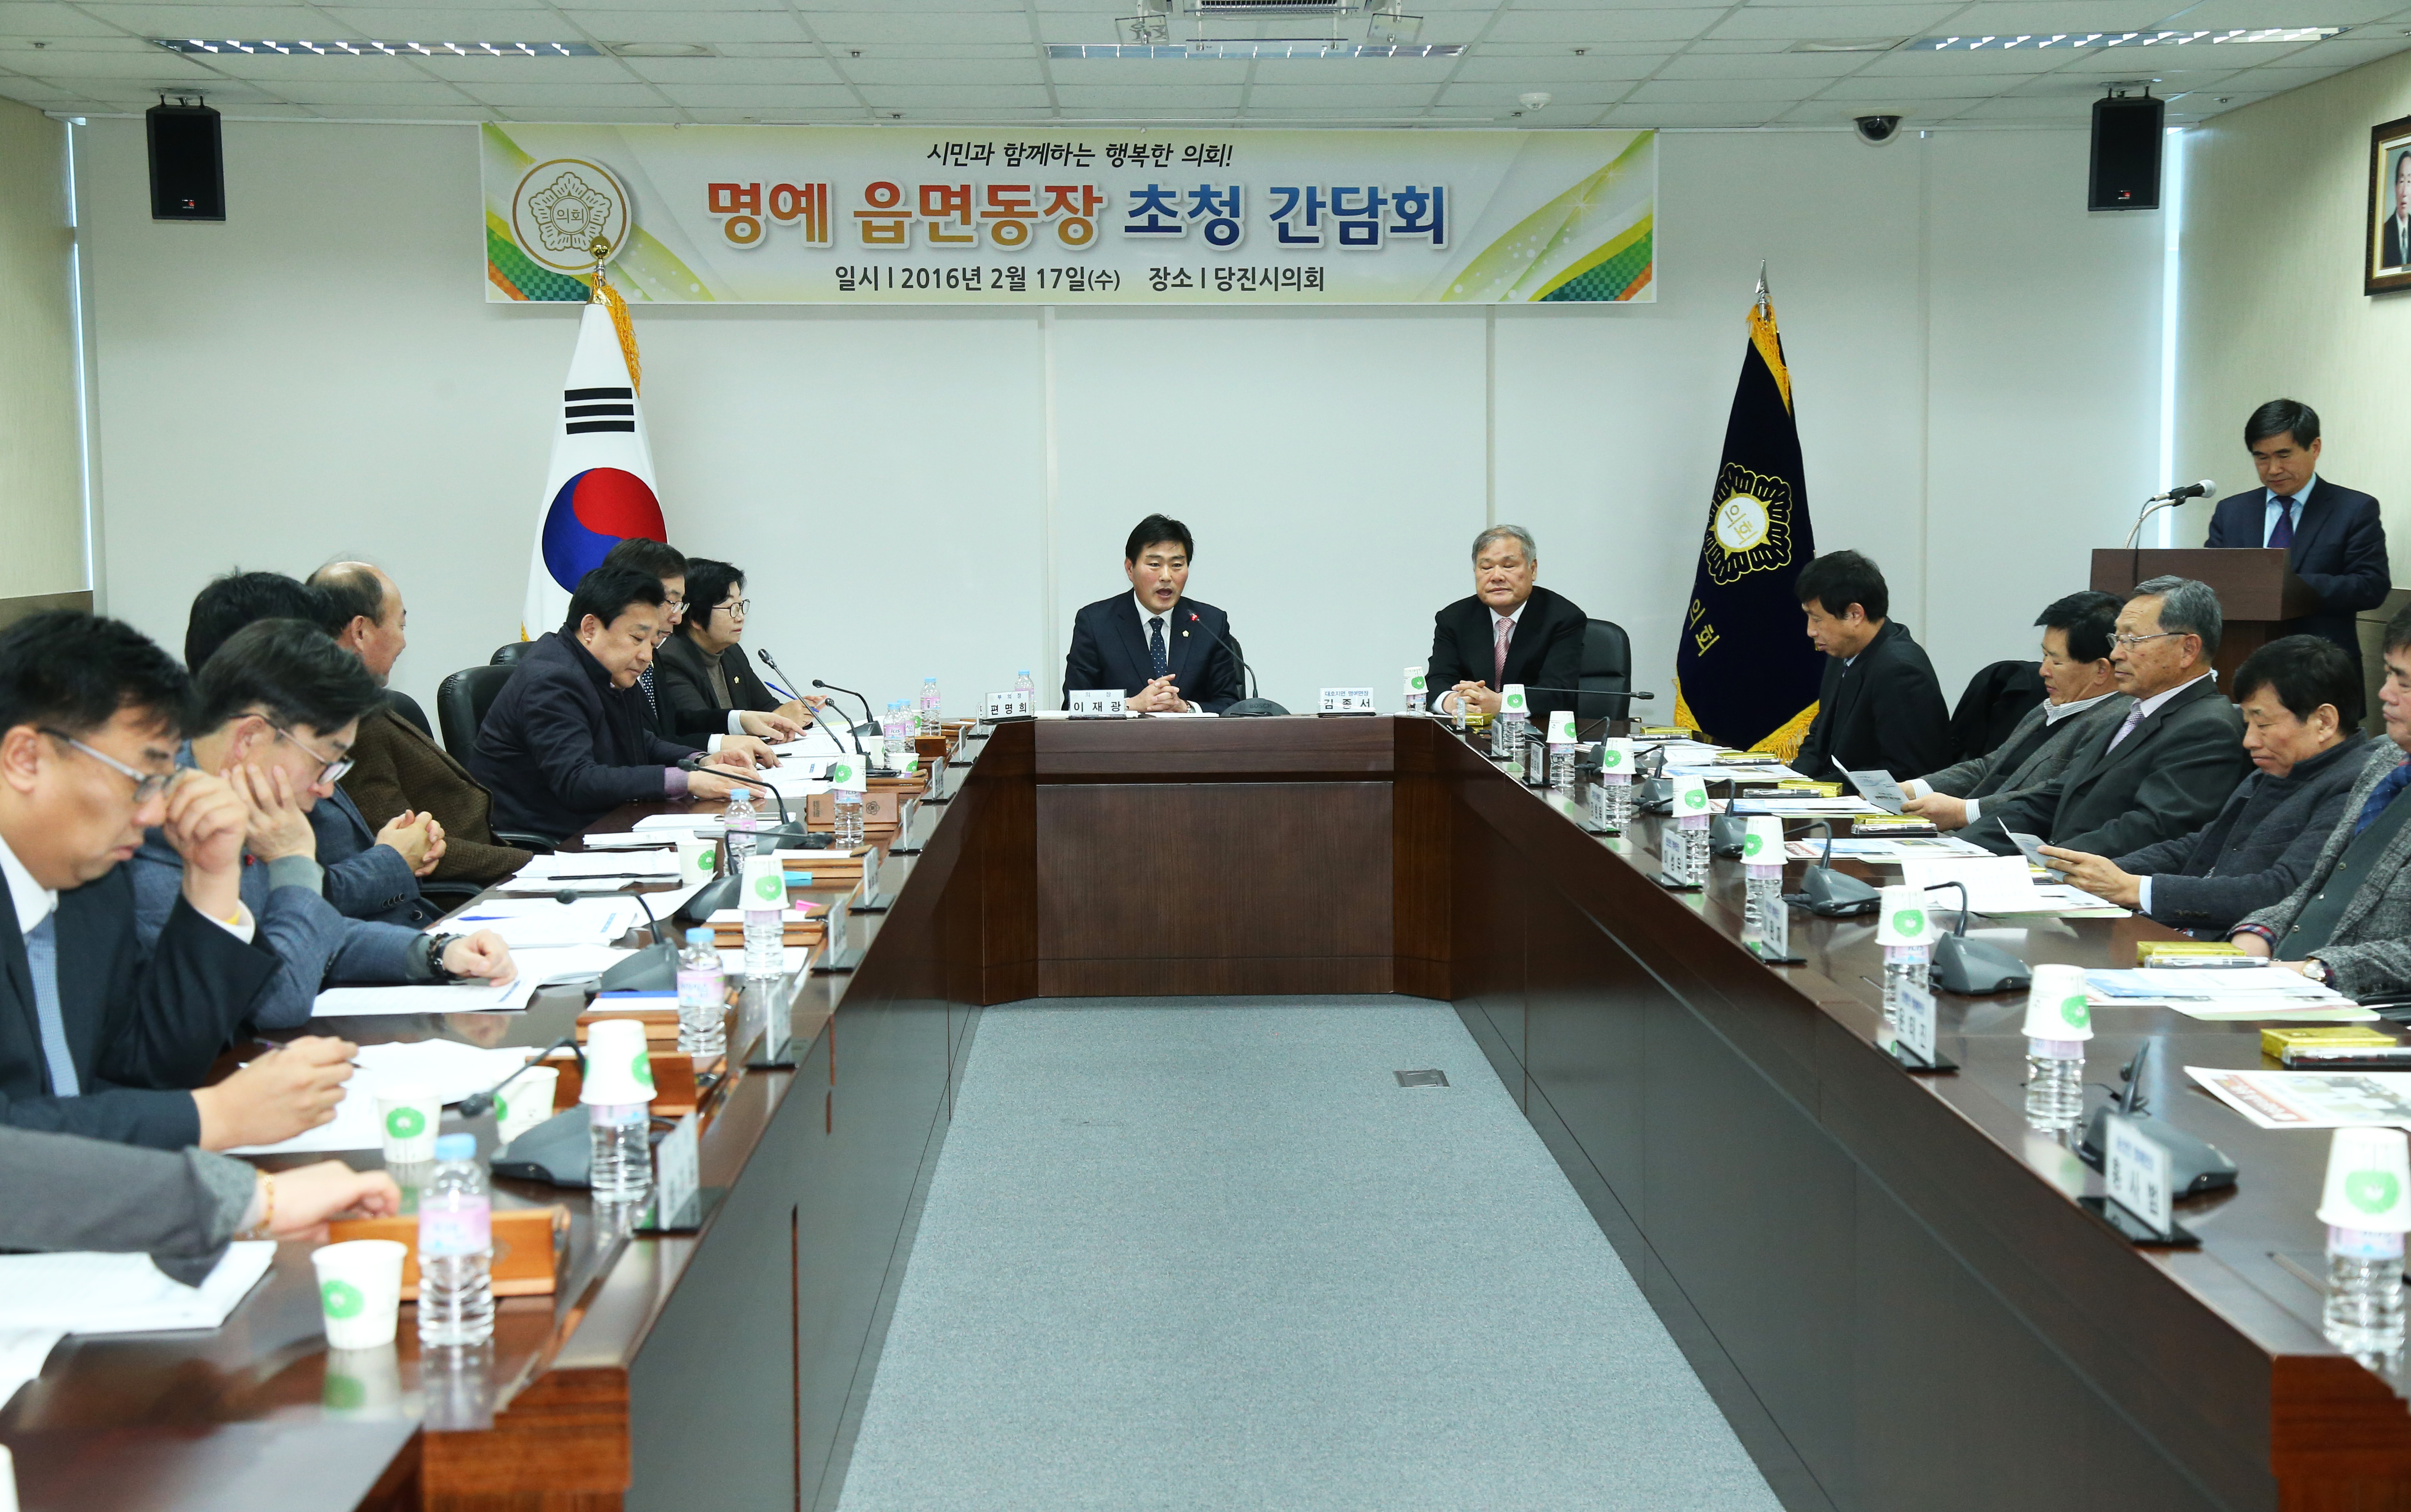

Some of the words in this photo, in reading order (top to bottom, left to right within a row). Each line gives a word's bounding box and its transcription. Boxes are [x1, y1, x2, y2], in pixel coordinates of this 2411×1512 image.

[926, 141, 995, 166] 시민과
[1004, 142, 1096, 167] 함께하는
[1106, 143, 1174, 168] 행복한
[1181, 143, 1233, 167] 의회!
[556, 208, 584, 224] 의회
[708, 182, 829, 244] 명예
[853, 181, 1104, 246] 읍면동장
[1124, 184, 1240, 246] 초청
[1269, 185, 1446, 245] 간담회
[835, 266, 878, 291] 일시
[901, 266, 981, 291] 2016년
[991, 266, 1026, 292] 2월
[1037, 266, 1120, 292] 17일(수)
[1149, 266, 1193, 292] 장소
[1215, 266, 1324, 292] 당진시의회
[1725, 504, 1758, 545] 의회
